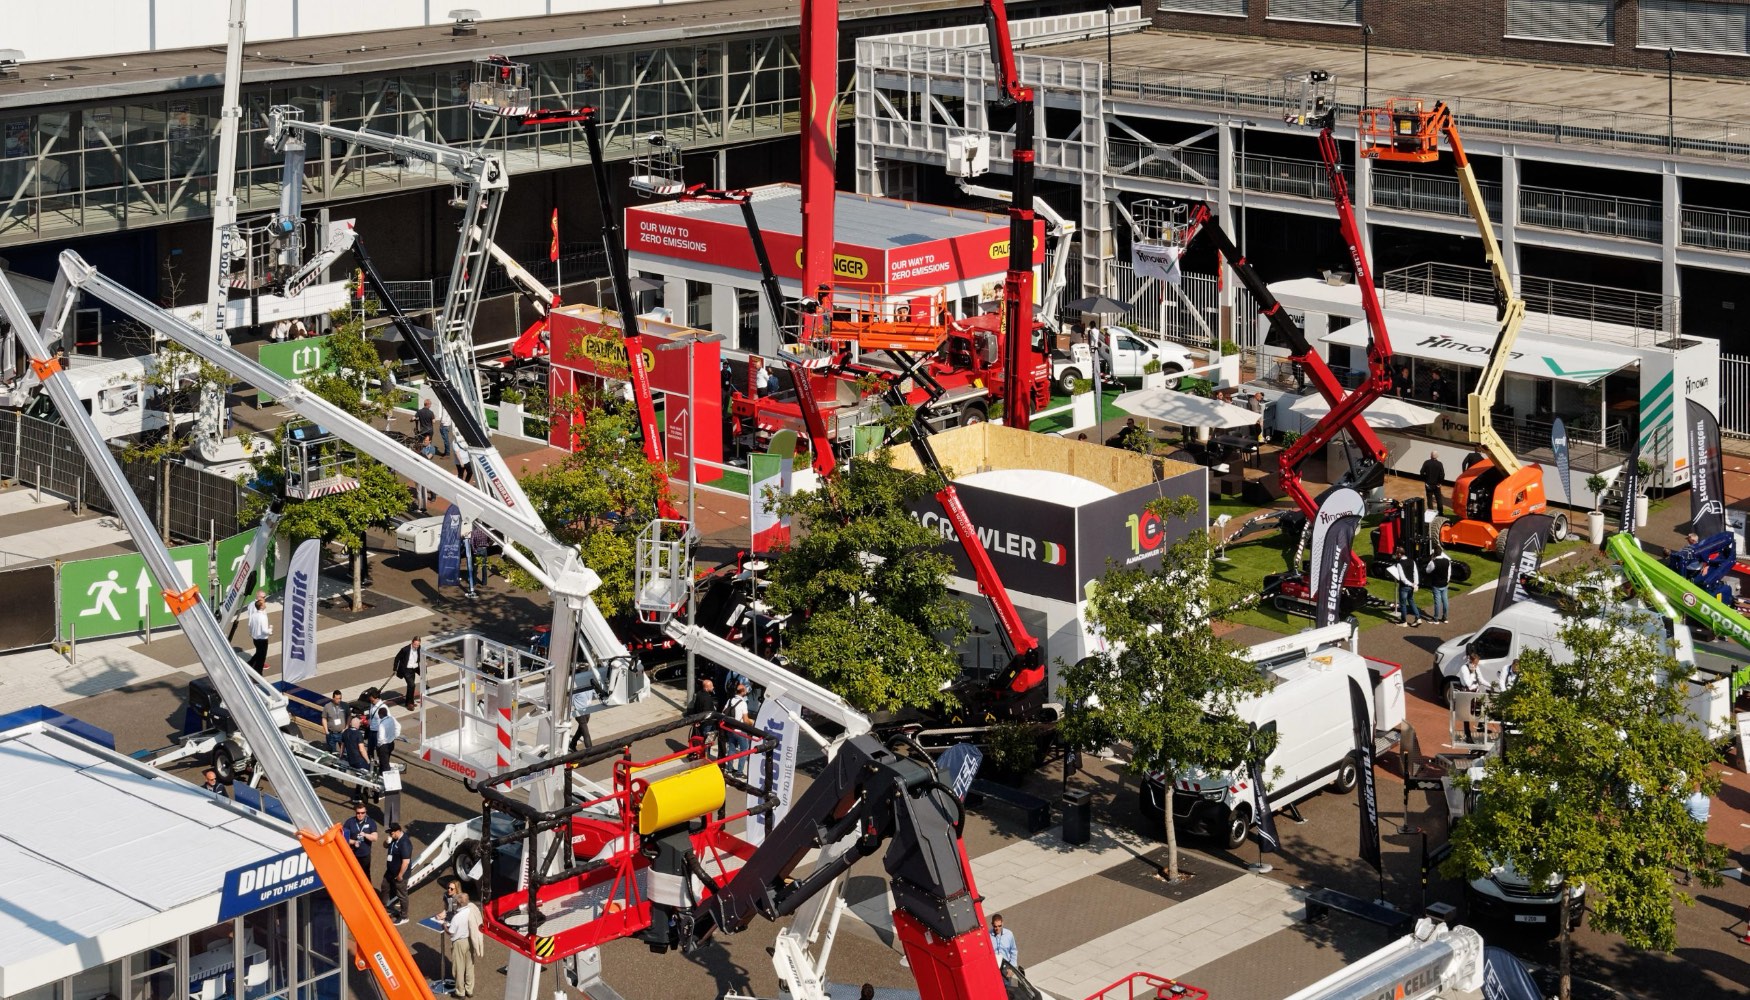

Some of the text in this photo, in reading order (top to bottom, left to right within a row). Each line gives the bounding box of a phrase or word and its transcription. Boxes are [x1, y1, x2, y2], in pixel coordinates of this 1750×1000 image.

[640, 221, 689, 238] OUR WAY TO
[640, 232, 707, 252] ZERO EMISSIONS
[891, 255, 935, 270] OUR WAY TO
[891, 261, 950, 281] ZERO EMISSIONS
[216, 302, 226, 330] LIFT
[1327, 544, 1342, 611] Elévateur
[441, 757, 477, 779] mateco
[783, 782, 790, 793] TO
[782, 795, 788, 807] UP
[260, 875, 314, 901] UP TO THE JOB
